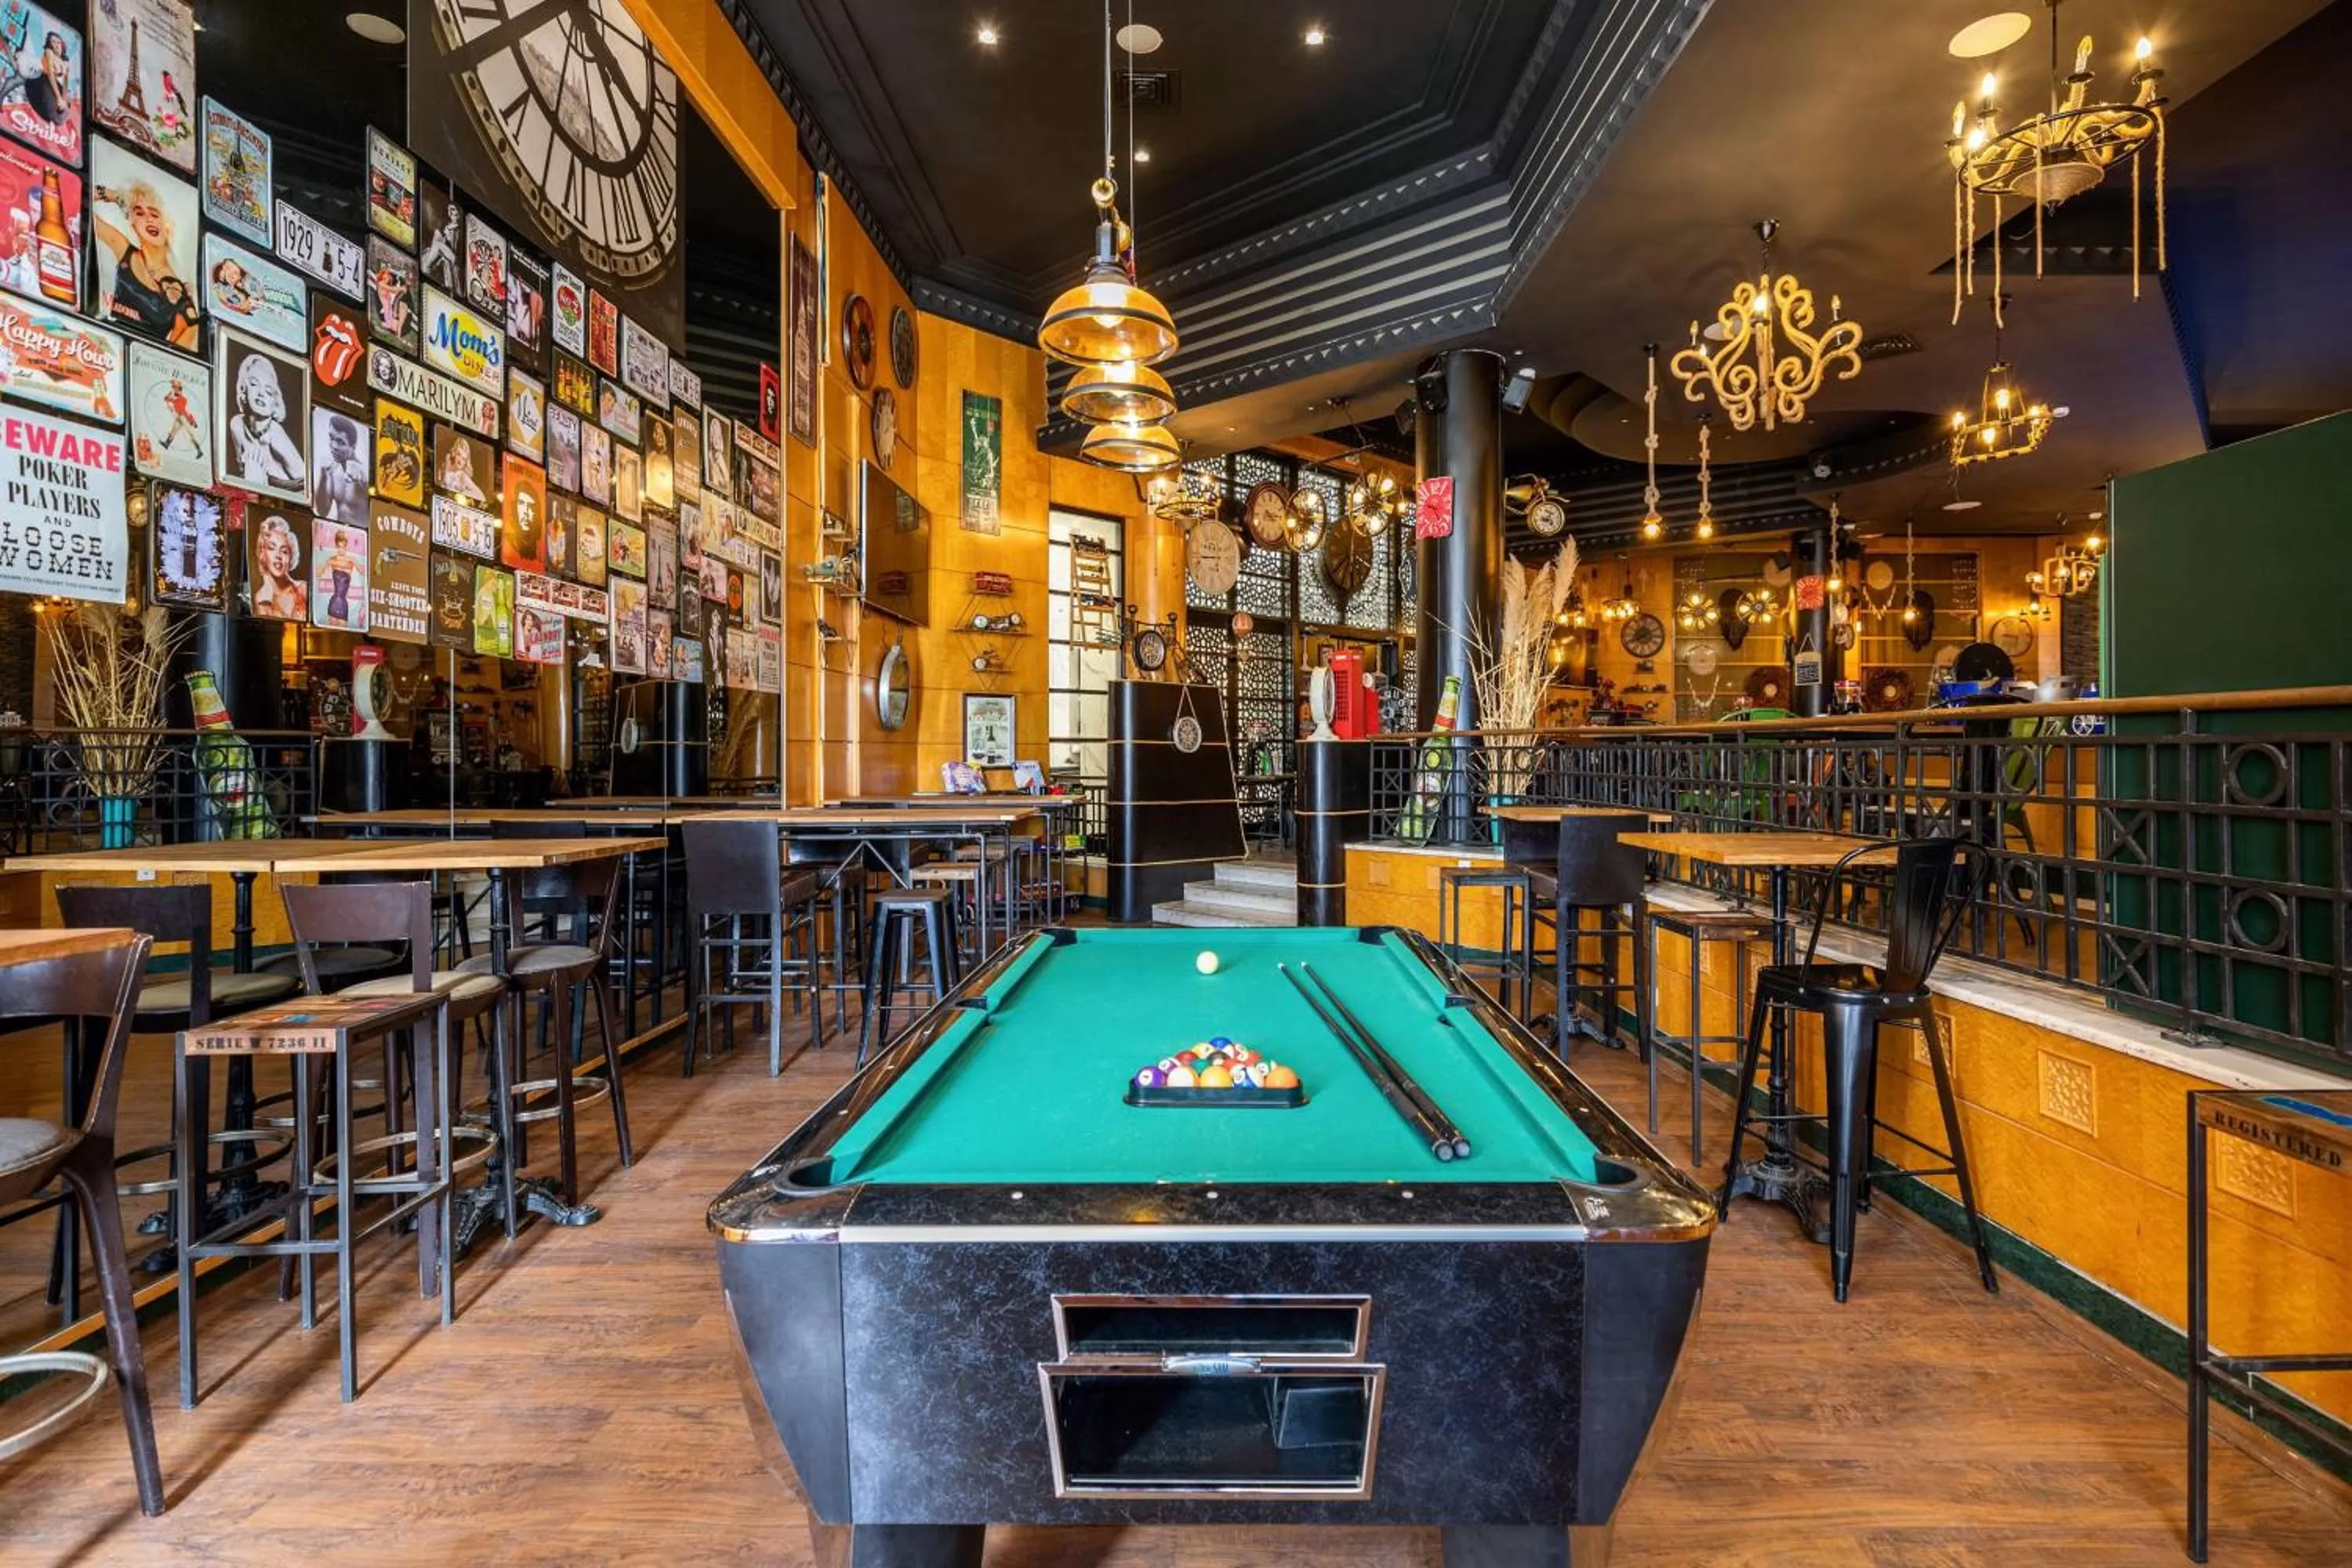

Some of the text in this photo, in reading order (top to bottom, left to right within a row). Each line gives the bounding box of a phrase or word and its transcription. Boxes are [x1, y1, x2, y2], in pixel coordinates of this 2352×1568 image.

[10, 110, 76, 148] Strike!
[283, 216, 314, 260] 1929
[0, 314, 61, 358] Happy
[429, 310, 499, 367] Mom's
[463, 354, 499, 383] DINER
[0, 418, 121, 474] EWARE
[19, 455, 88, 491] POKER
[8, 481, 101, 520] PLAYERS
[3, 521, 103, 557] LOOSE
[43, 514, 73, 528] AND
[377, 516, 426, 546] COWBOYS
[0, 546, 114, 581] WOMEN
[370, 611, 426, 635] BARTENDER
[197, 1037, 243, 1049] SERIE
[269, 1037, 306, 1049] 7236
[2214, 1110, 2342, 1167] REGISTERED
